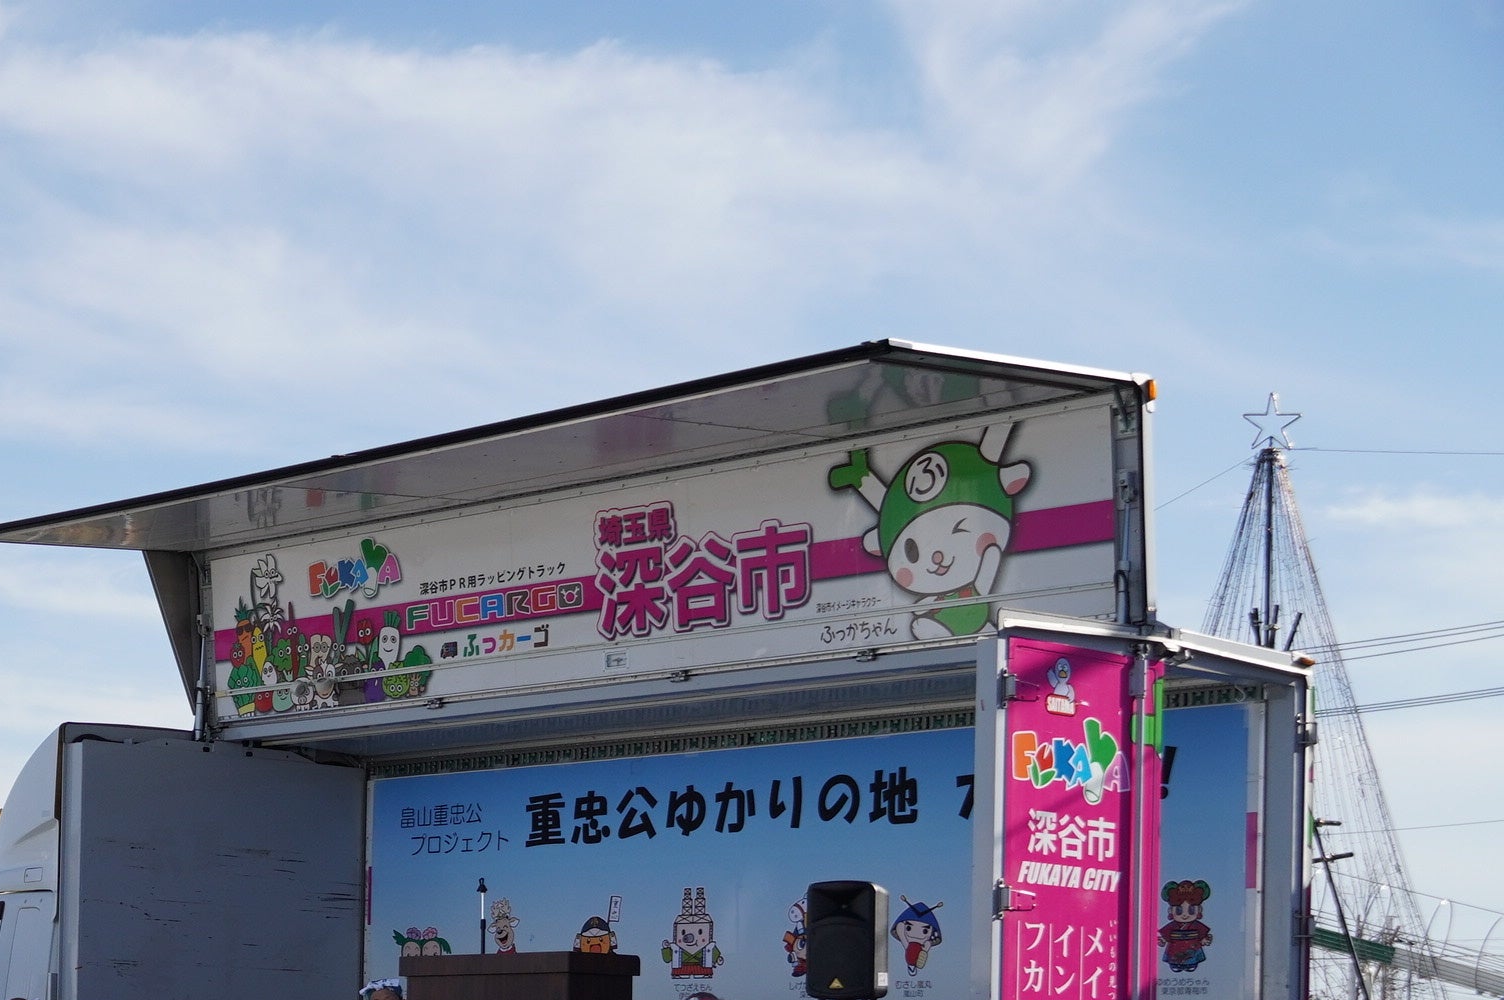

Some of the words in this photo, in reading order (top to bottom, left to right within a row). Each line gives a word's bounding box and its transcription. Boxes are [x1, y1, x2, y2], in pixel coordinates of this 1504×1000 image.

[909, 456, 945, 497] ふ
[598, 507, 673, 544] 埼玉県
[598, 524, 810, 636] 深谷市
[463, 624, 549, 657] ふっカーゴ
[820, 617, 898, 644] ふっかちゃん
[400, 802, 483, 829] 畠山重忠公
[524, 765, 920, 848] 重忠公ゆかりの地
[411, 830, 509, 856] プロジェクト
[1027, 808, 1116, 862] 深谷市
[1017, 860, 1083, 890] FUKAYA
[1083, 866, 1121, 893] CITY
[1054, 925, 1075, 995] イン
